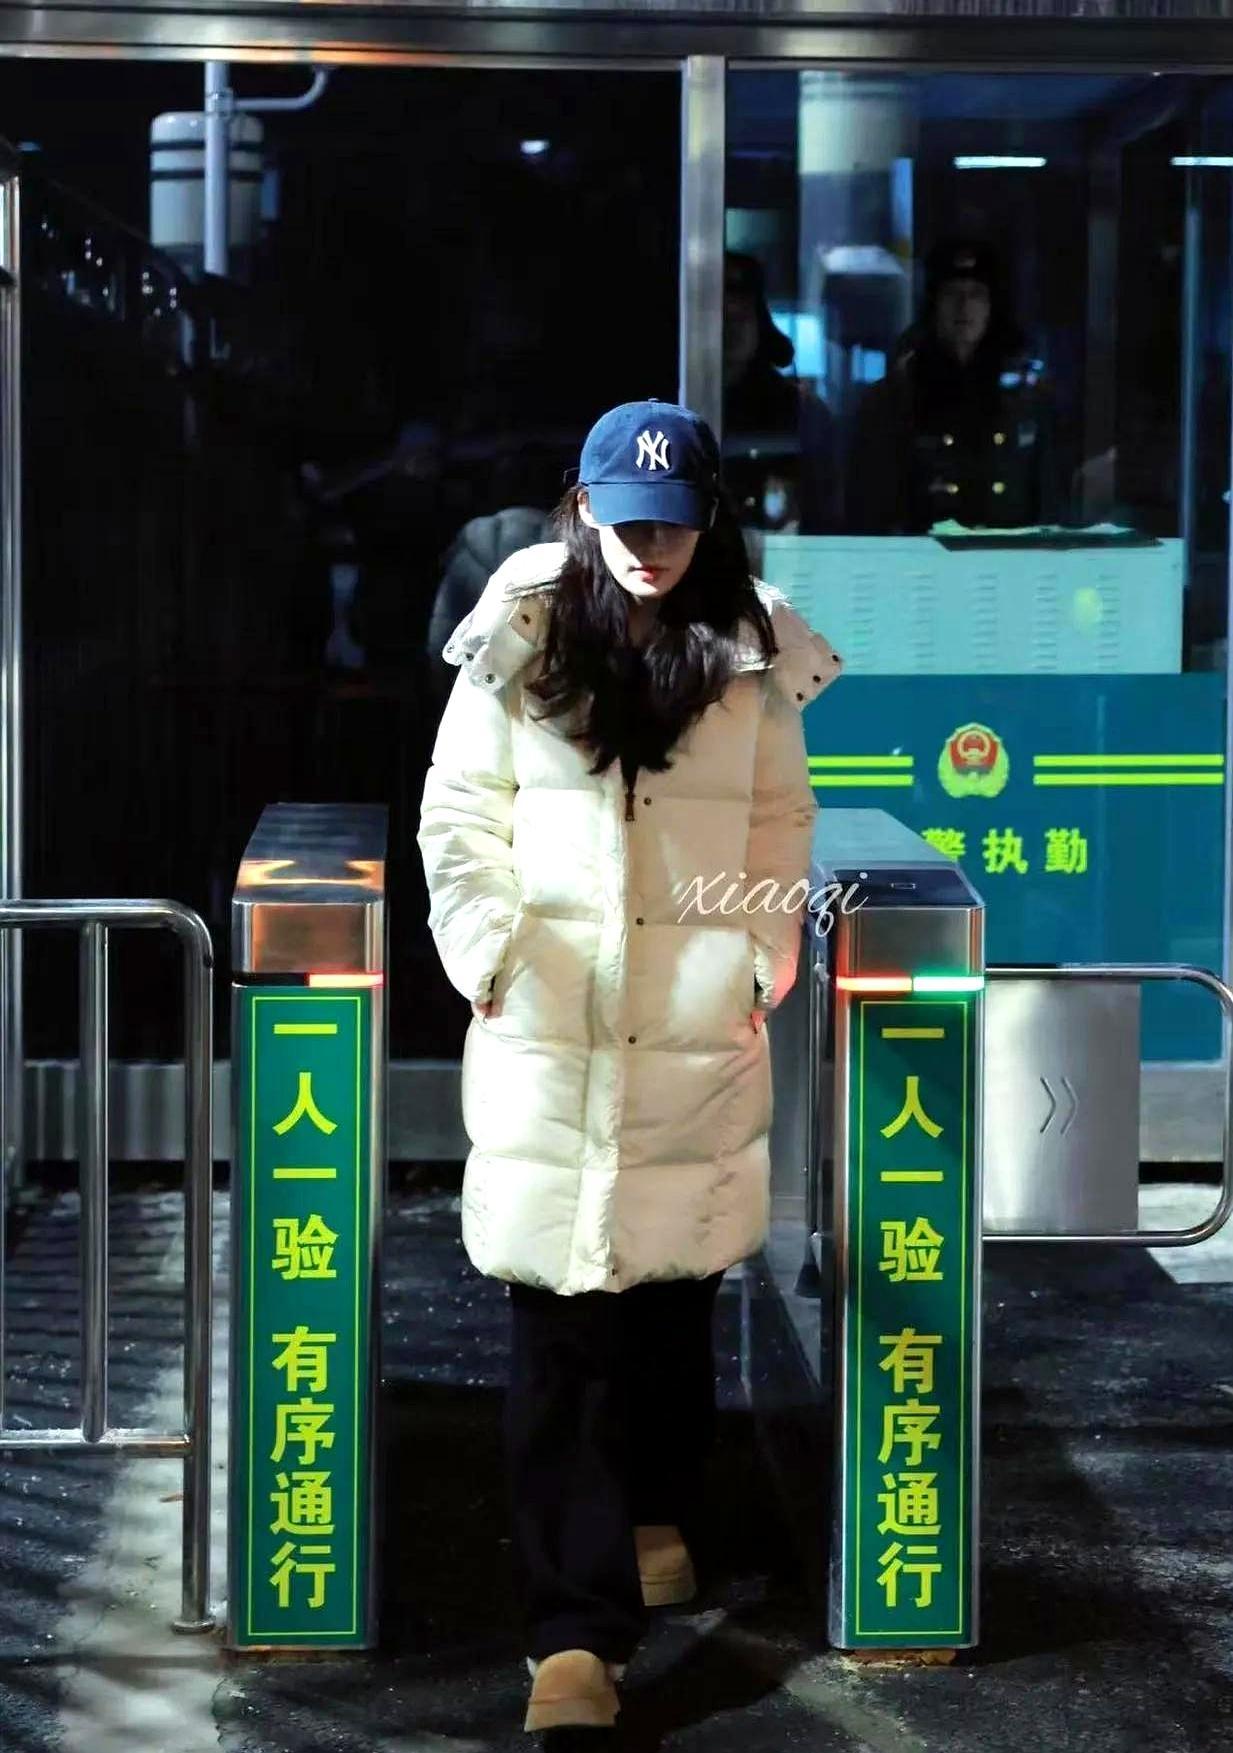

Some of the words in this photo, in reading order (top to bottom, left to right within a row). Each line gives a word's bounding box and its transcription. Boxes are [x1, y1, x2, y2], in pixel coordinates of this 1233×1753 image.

[636, 430, 670, 470] NY
[272, 1023, 338, 1280] 一人一验
[879, 1028, 945, 1282] 一人一验
[270, 1325, 337, 1608] 有序通行
[876, 1328, 943, 1608] 有序通行
